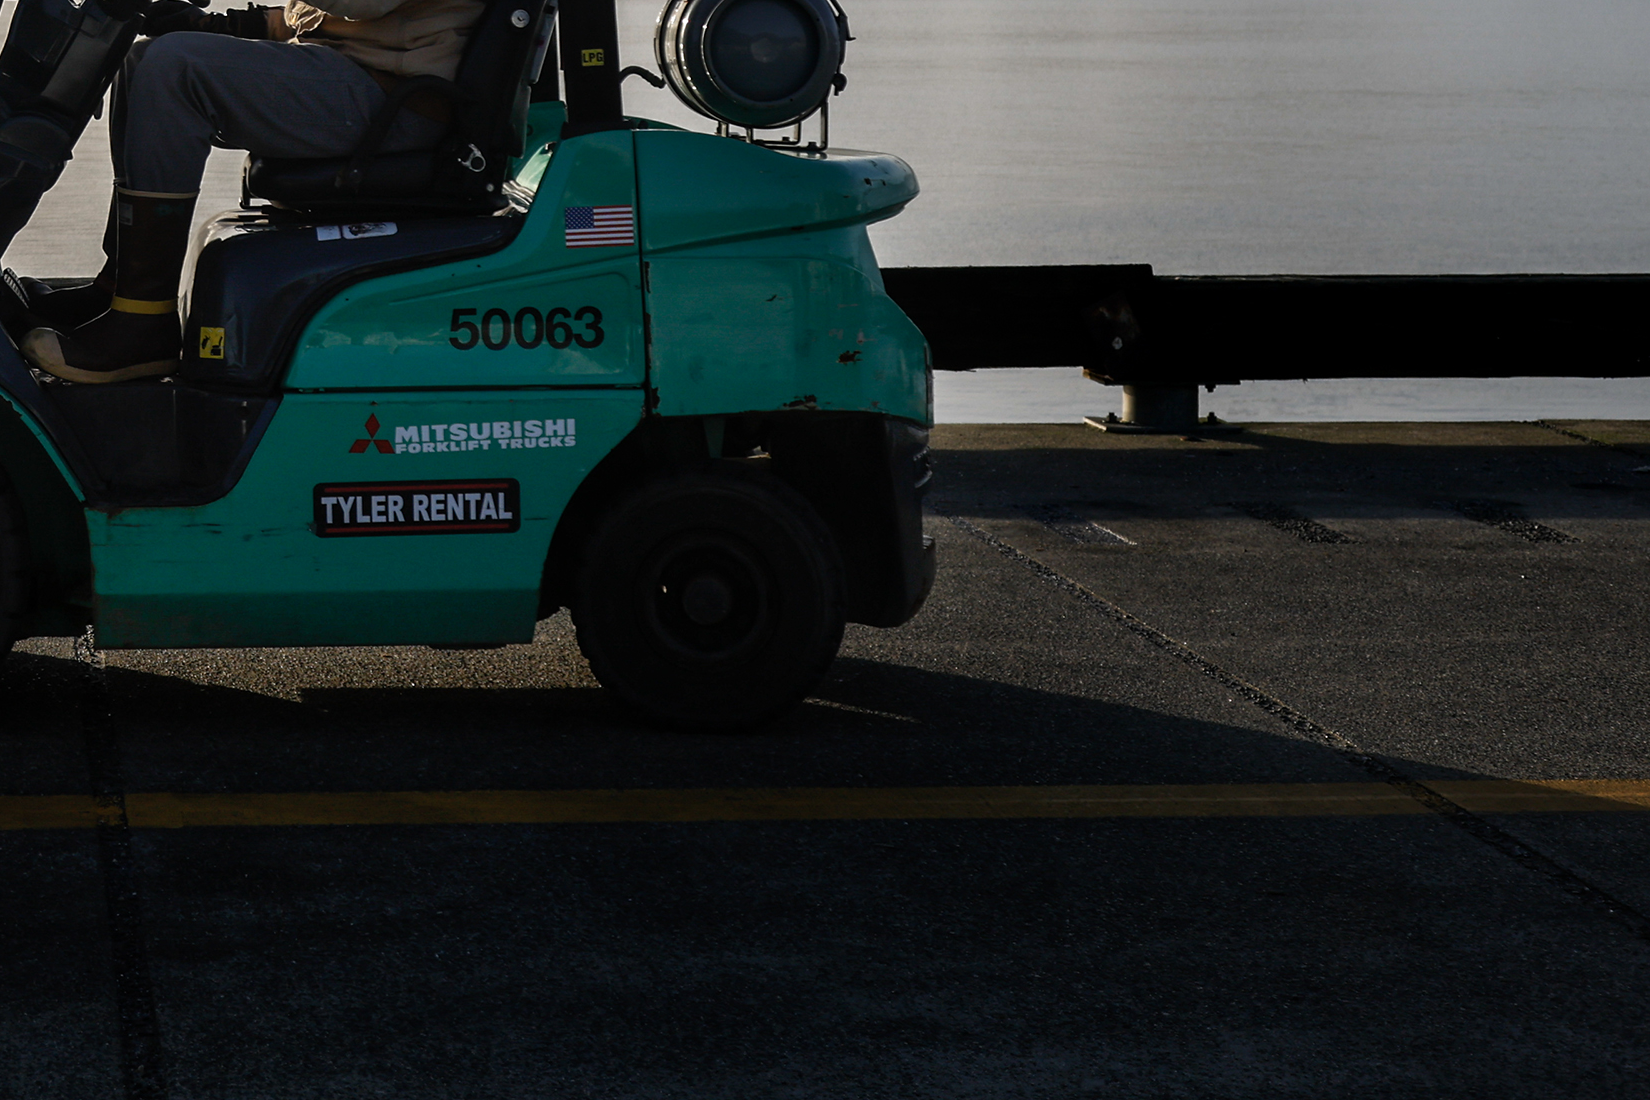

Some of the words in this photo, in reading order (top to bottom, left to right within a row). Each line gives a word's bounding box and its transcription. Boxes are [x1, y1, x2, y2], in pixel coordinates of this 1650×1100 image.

[582, 52, 603, 63] LPG
[449, 305, 605, 351] 50063
[395, 418, 576, 443] MITSUBISHI
[395, 440, 492, 454] FORKLIFT
[498, 436, 577, 450] TRUCKS
[321, 494, 405, 524] TYLER
[413, 492, 513, 523] RENTAL
